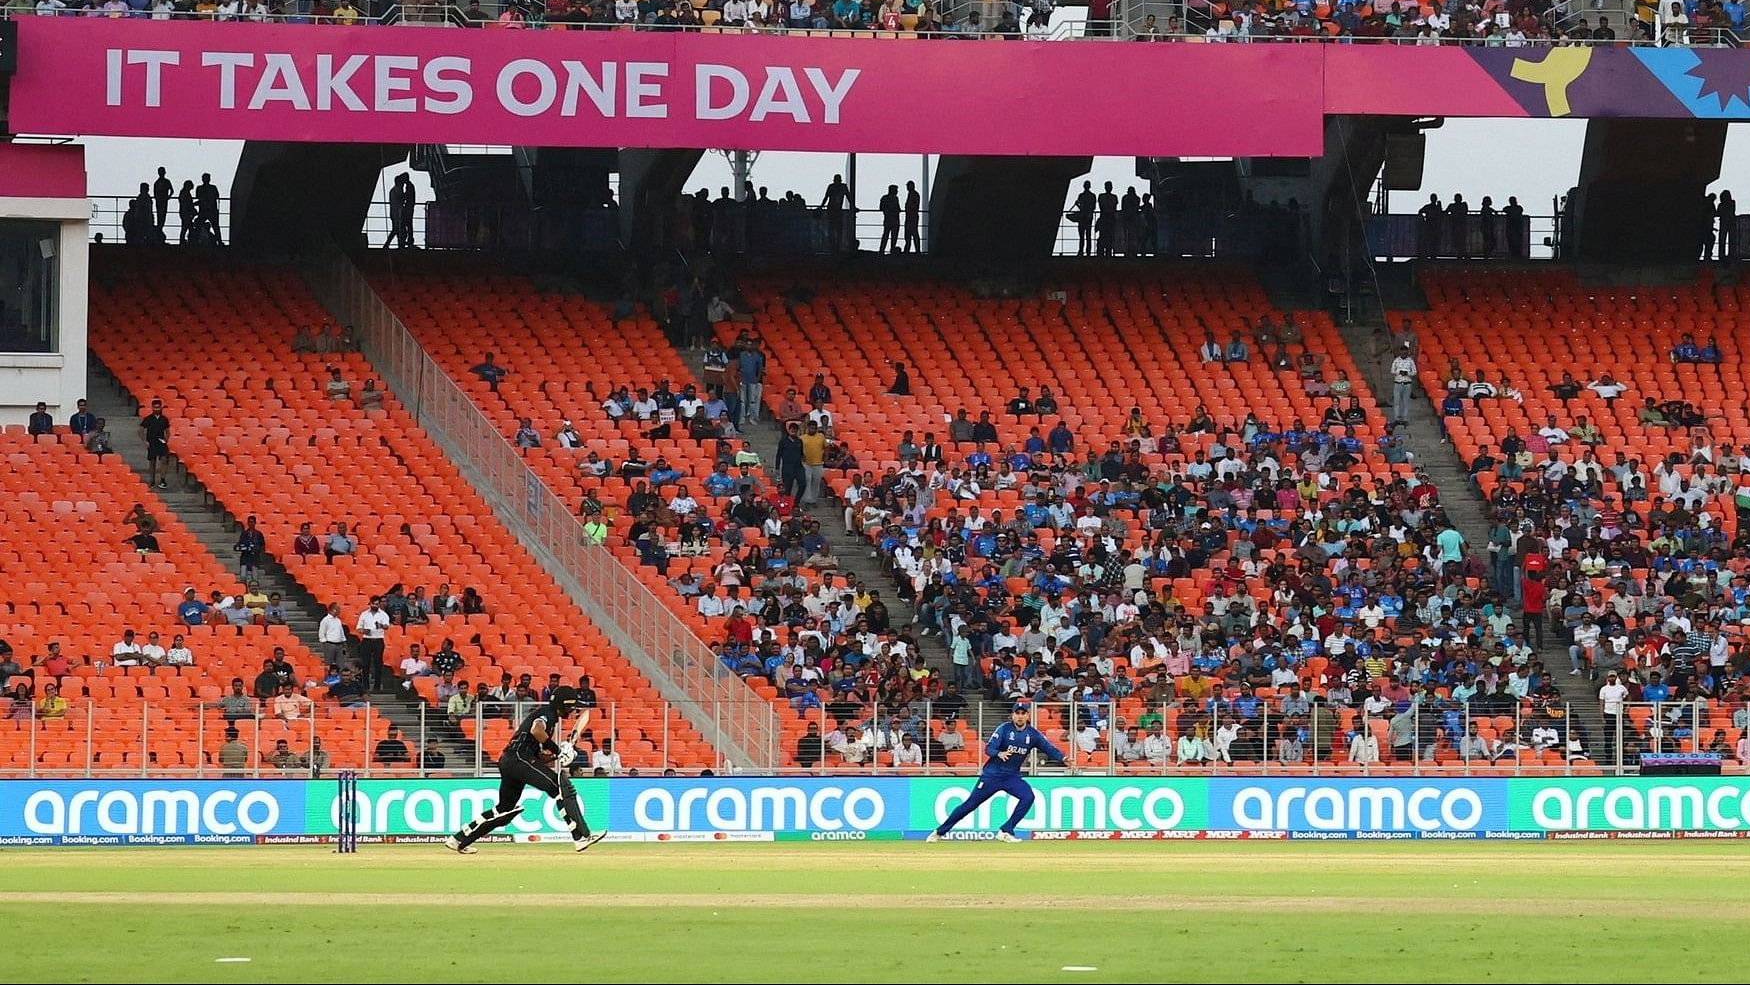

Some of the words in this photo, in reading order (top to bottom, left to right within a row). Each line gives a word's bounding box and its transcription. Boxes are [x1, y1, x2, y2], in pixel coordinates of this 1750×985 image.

[888, 16, 896, 28] 4
[107, 49, 179, 107] IT
[201, 52, 473, 114] TAKES
[496, 59, 669, 118] ONE
[695, 63, 861, 124] DAY
[24, 789, 280, 834] aramco
[634, 787, 885, 831] aramco
[934, 787, 1184, 830] aramco
[1233, 787, 1483, 830] aramco
[128, 835, 185, 845] Booking.com
[194, 834, 250, 844] Booking.com
[812, 830, 865, 840] aramco
[1292, 831, 1347, 840] Booking.com
[1356, 831, 1412, 840] Booking.com
[1421, 830, 1476, 840] Booking.com
[1486, 830, 1540, 840] Booking.com
[62, 836, 118, 846] Booking.com
